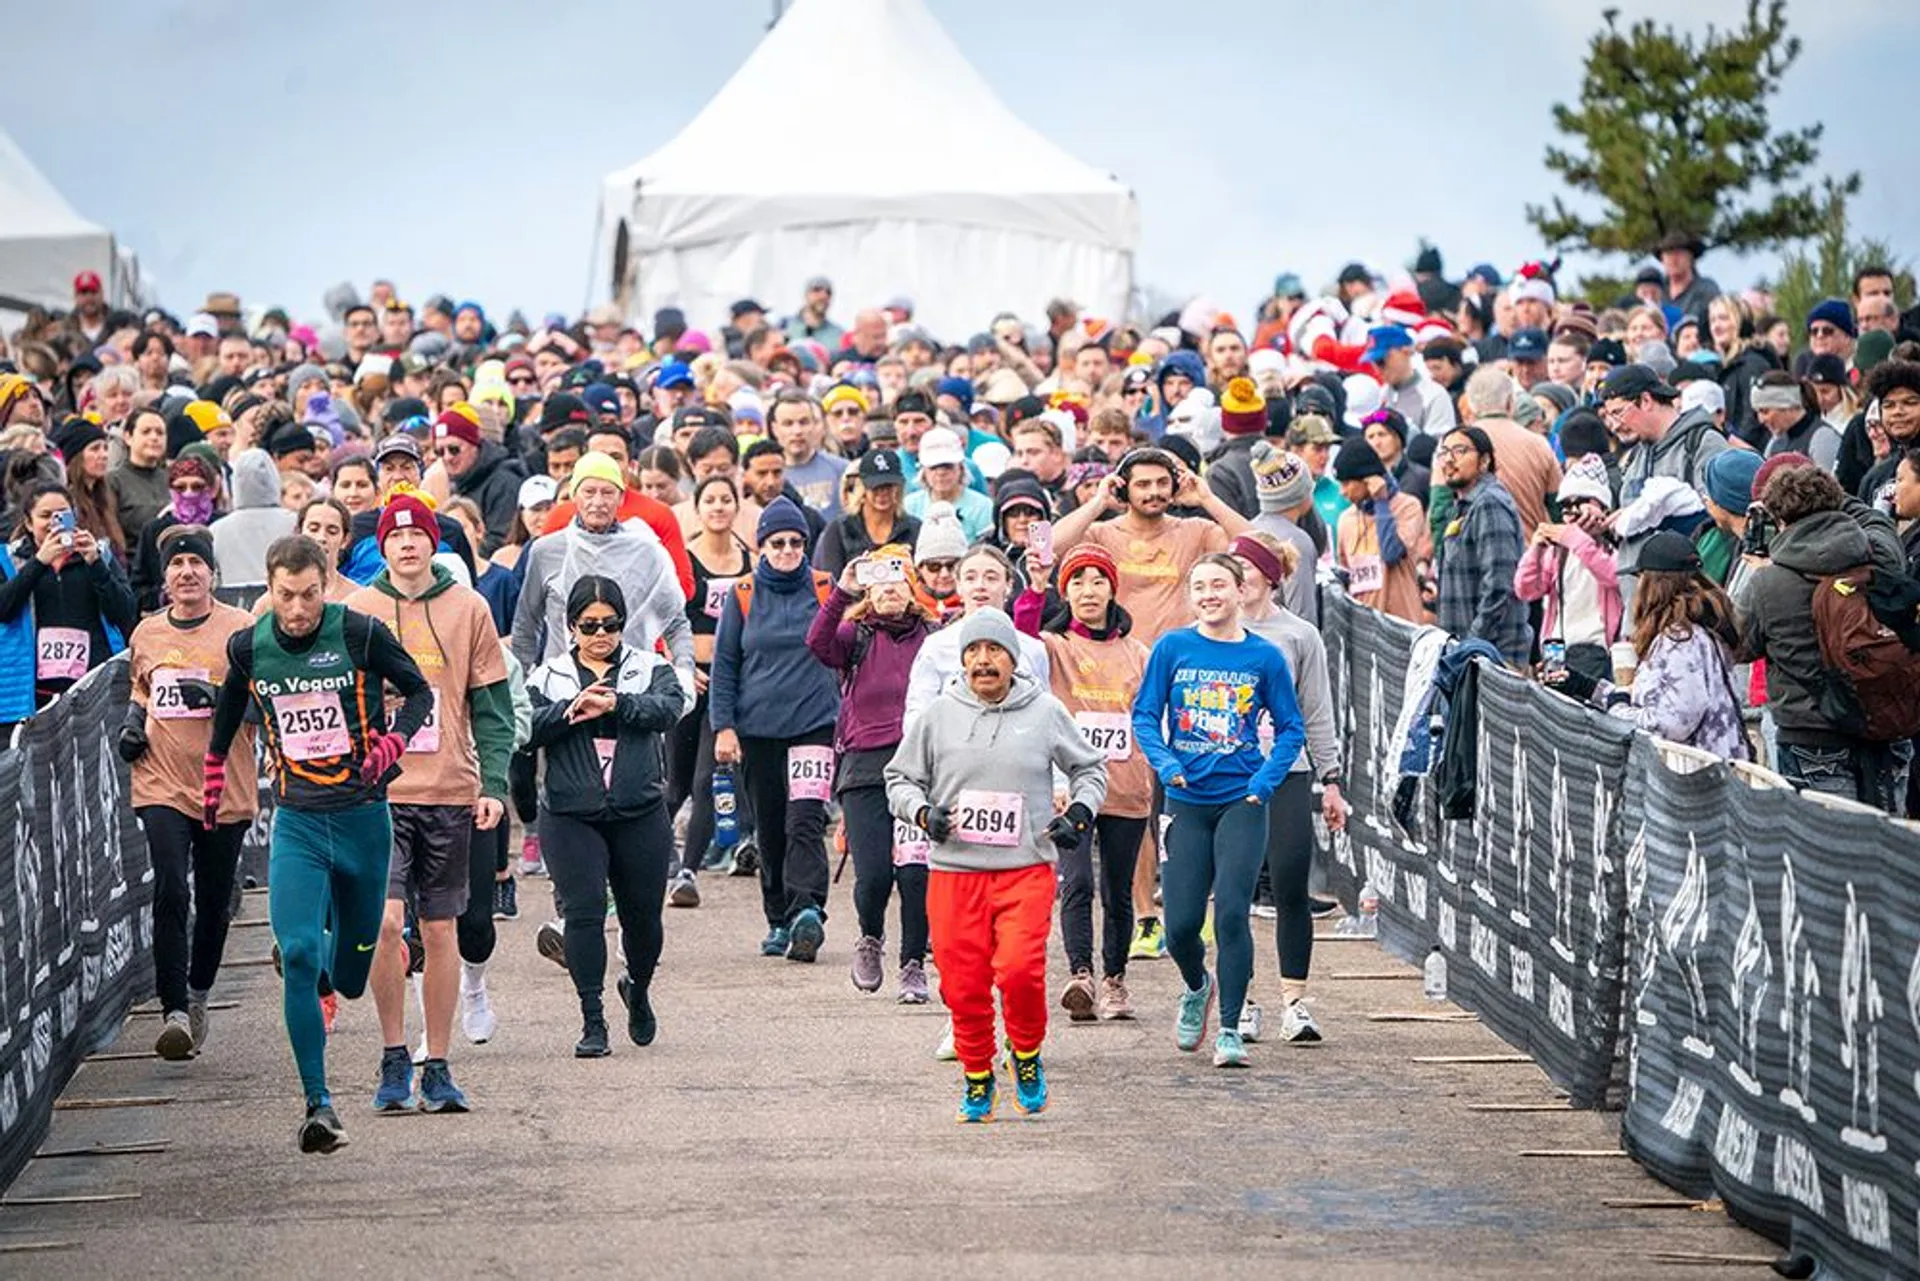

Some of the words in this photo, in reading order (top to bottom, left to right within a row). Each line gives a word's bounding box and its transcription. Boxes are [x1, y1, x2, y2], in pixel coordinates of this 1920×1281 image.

[42, 642, 86, 662] 2872
[256, 680, 281, 695] Go
[285, 671, 354, 693] Vegan!
[281, 706, 341, 735] 2552
[961, 807, 1016, 834] 2694
